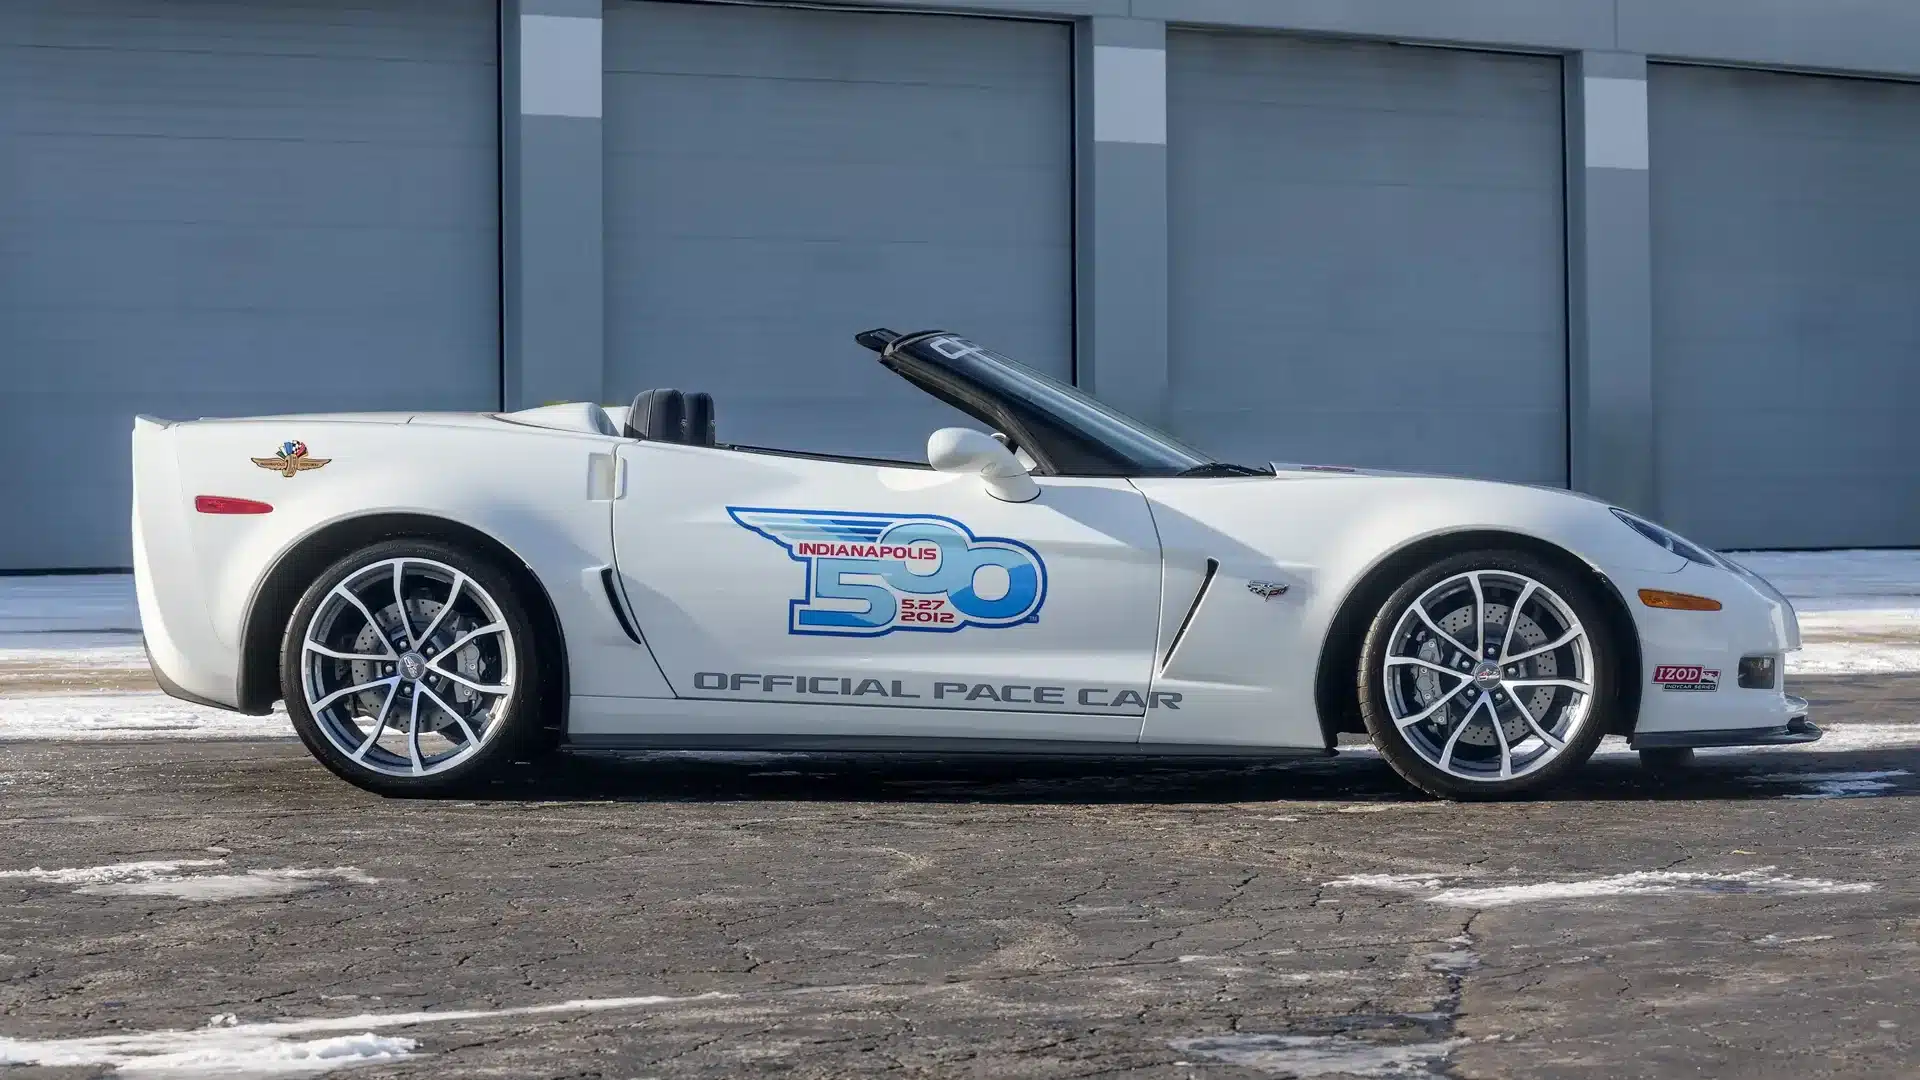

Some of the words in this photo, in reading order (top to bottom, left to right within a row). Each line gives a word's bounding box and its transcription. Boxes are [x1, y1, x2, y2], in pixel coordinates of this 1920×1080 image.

[798, 542, 937, 560] INDIANAPOLIS
[798, 522, 1039, 628] 500
[900, 598, 945, 611] 5.27
[900, 610, 955, 624] 2012
[1657, 667, 1699, 681] IZOD
[692, 671, 921, 700] OFFICIAL
[932, 681, 1065, 705] PACE
[1076, 687, 1184, 711] CAR
